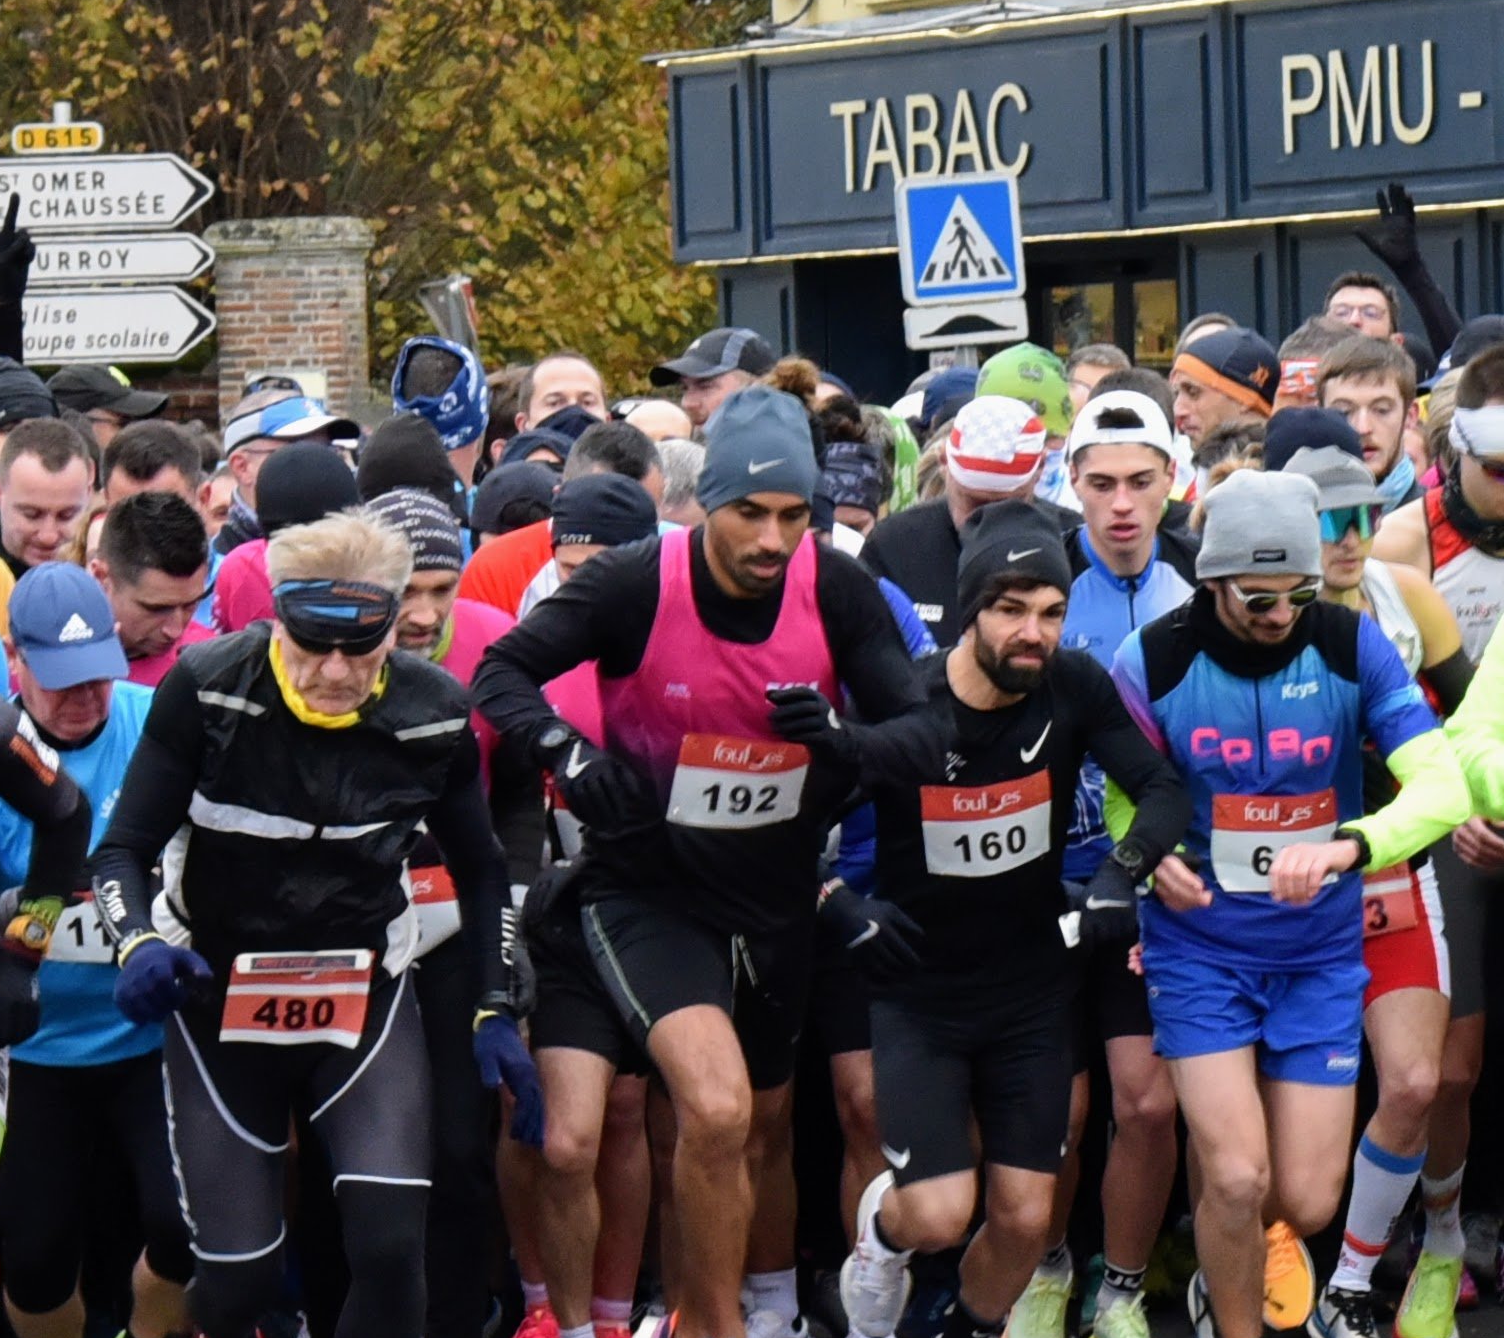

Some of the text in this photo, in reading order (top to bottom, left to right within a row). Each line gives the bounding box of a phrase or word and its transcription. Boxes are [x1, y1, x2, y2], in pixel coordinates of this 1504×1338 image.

[1281, 39, 1435, 155] PMU
[21, 129, 92, 148] D 615
[829, 81, 1032, 194] TABAC
[32, 172, 106, 192] OMER
[29, 191, 166, 219] CHAUSSÉE
[85, 328, 170, 351] scolaire
[713, 737, 785, 771] foules
[703, 784, 780, 814] 192
[953, 791, 1022, 814] foules
[1244, 799, 1314, 827] foules
[954, 825, 1027, 863] 160
[252, 996, 336, 1030] 480
